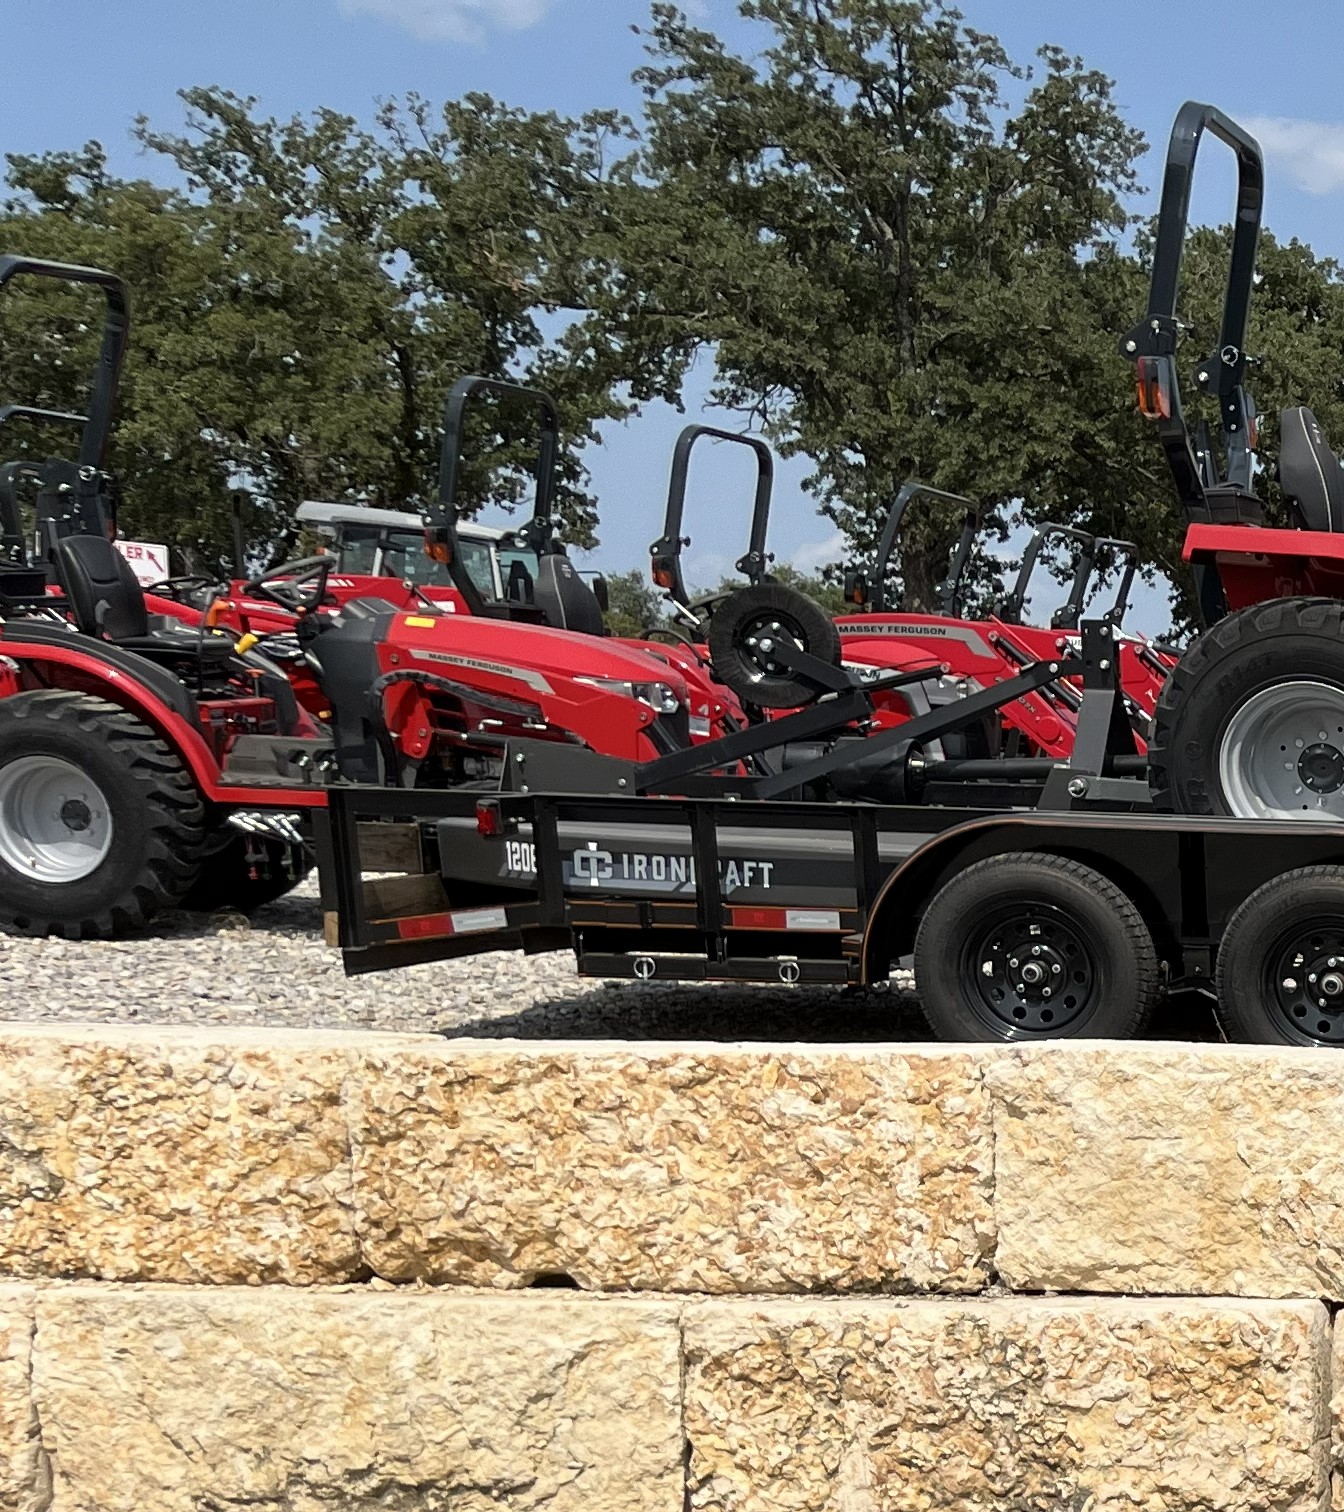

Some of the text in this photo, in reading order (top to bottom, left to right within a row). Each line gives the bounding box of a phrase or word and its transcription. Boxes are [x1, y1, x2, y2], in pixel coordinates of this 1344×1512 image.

[838, 625, 947, 636] MASSEY FERGUSON
[466, 659, 513, 675] FERGUSON
[622, 853, 774, 889] IRONAFT
